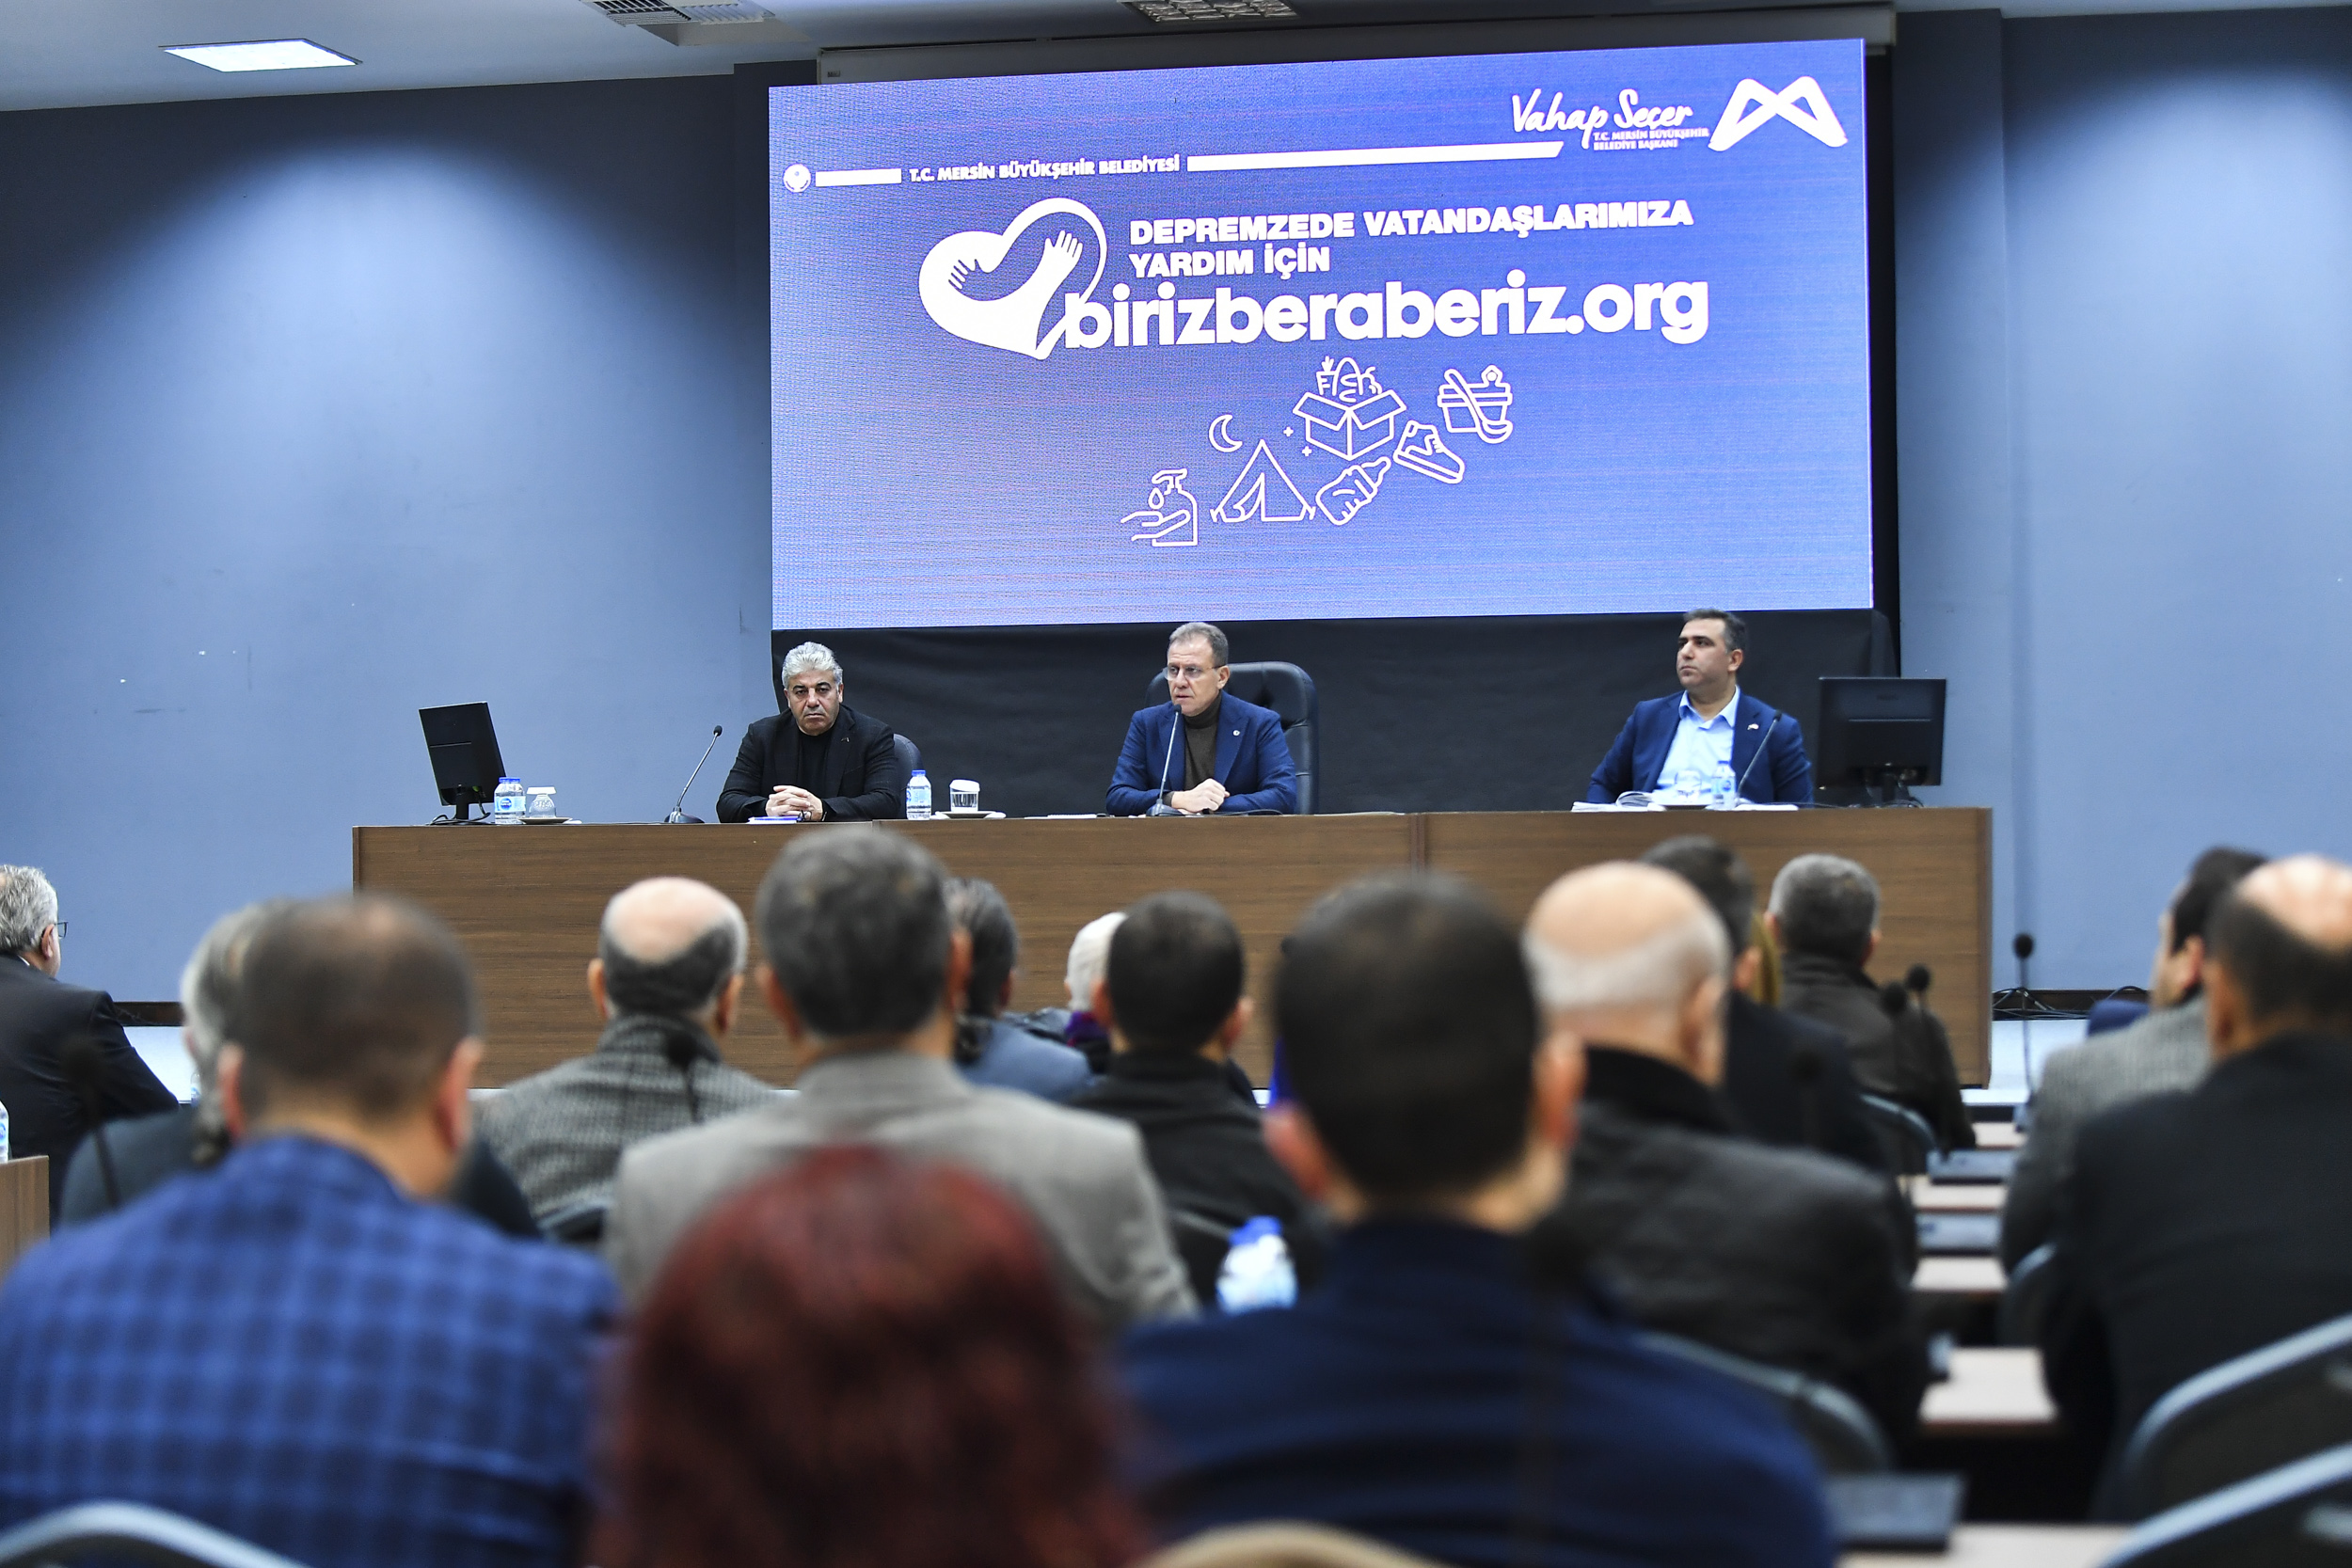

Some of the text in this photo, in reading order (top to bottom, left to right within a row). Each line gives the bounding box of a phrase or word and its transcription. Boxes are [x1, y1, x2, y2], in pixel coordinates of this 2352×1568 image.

[1512, 88, 1693, 150] Vahap Seçer
[909, 153, 1180, 182] T.C. MERSİN BÜYÜKŞEHİR BELEDİYESİ
[1130, 199, 1694, 245] DEPREMZEDE VATANDAŞLARIMIZA
[1129, 243, 1330, 280] YARDIM İÇİN
[1065, 269, 1709, 349] birizberaberiz.org
